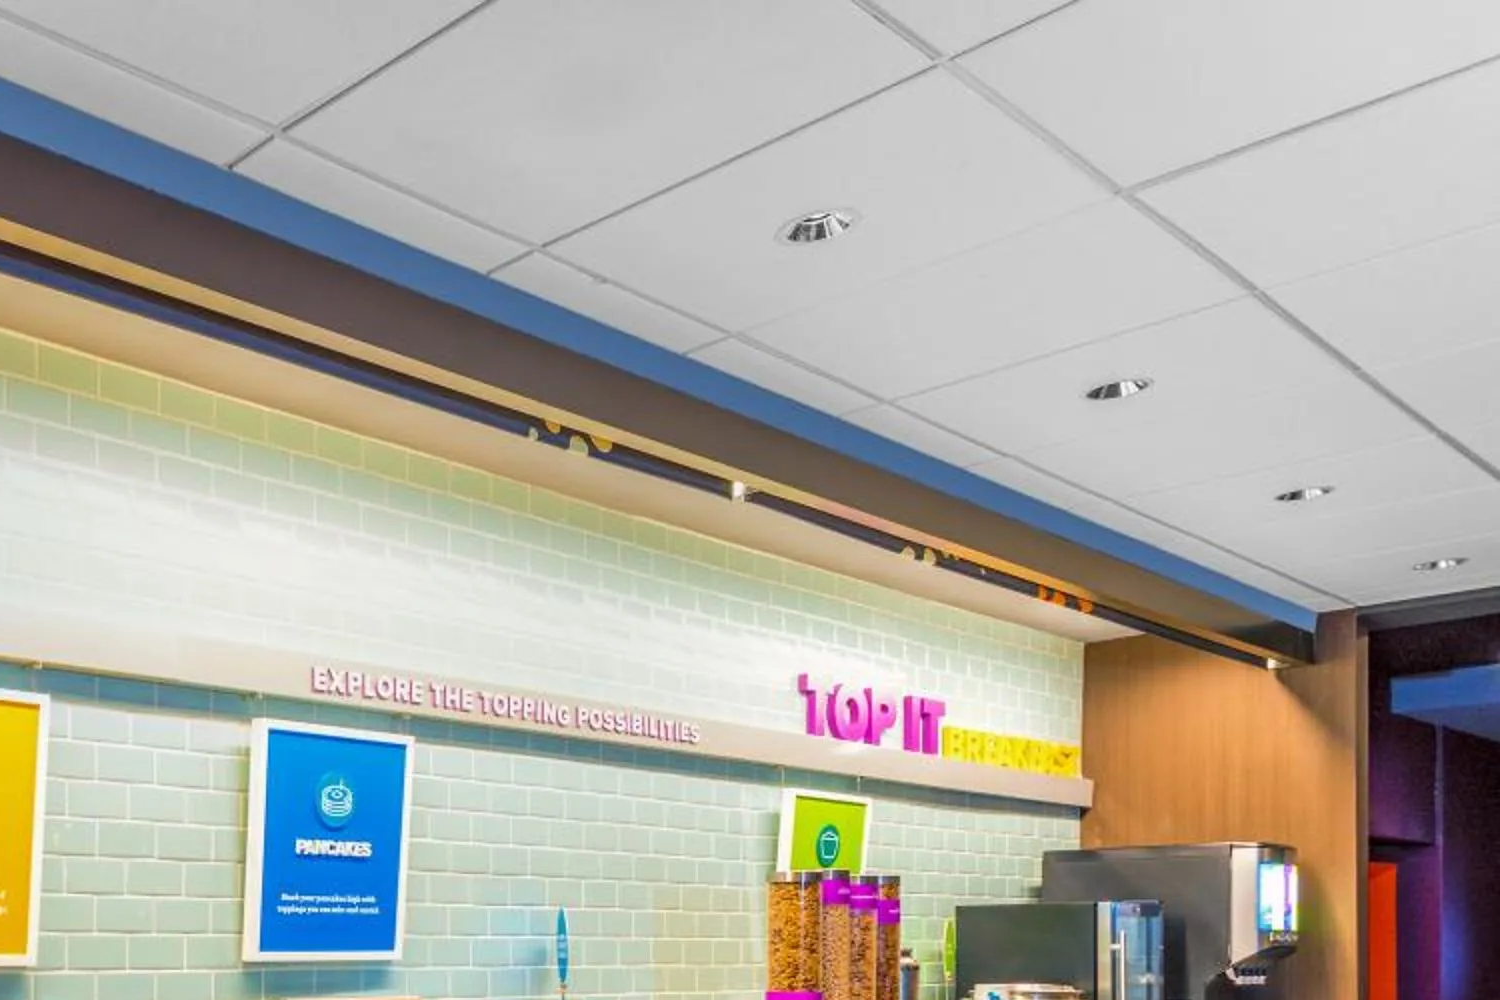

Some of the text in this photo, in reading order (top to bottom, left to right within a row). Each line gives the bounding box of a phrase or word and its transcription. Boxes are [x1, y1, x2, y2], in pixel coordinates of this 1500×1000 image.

[311, 665, 702, 744] EXPLORE THE TOPPING POSSIBILITIES
[797, 673, 897, 745] TOP
[903, 694, 946, 755] IT
[295, 839, 373, 858] PANCAKES
